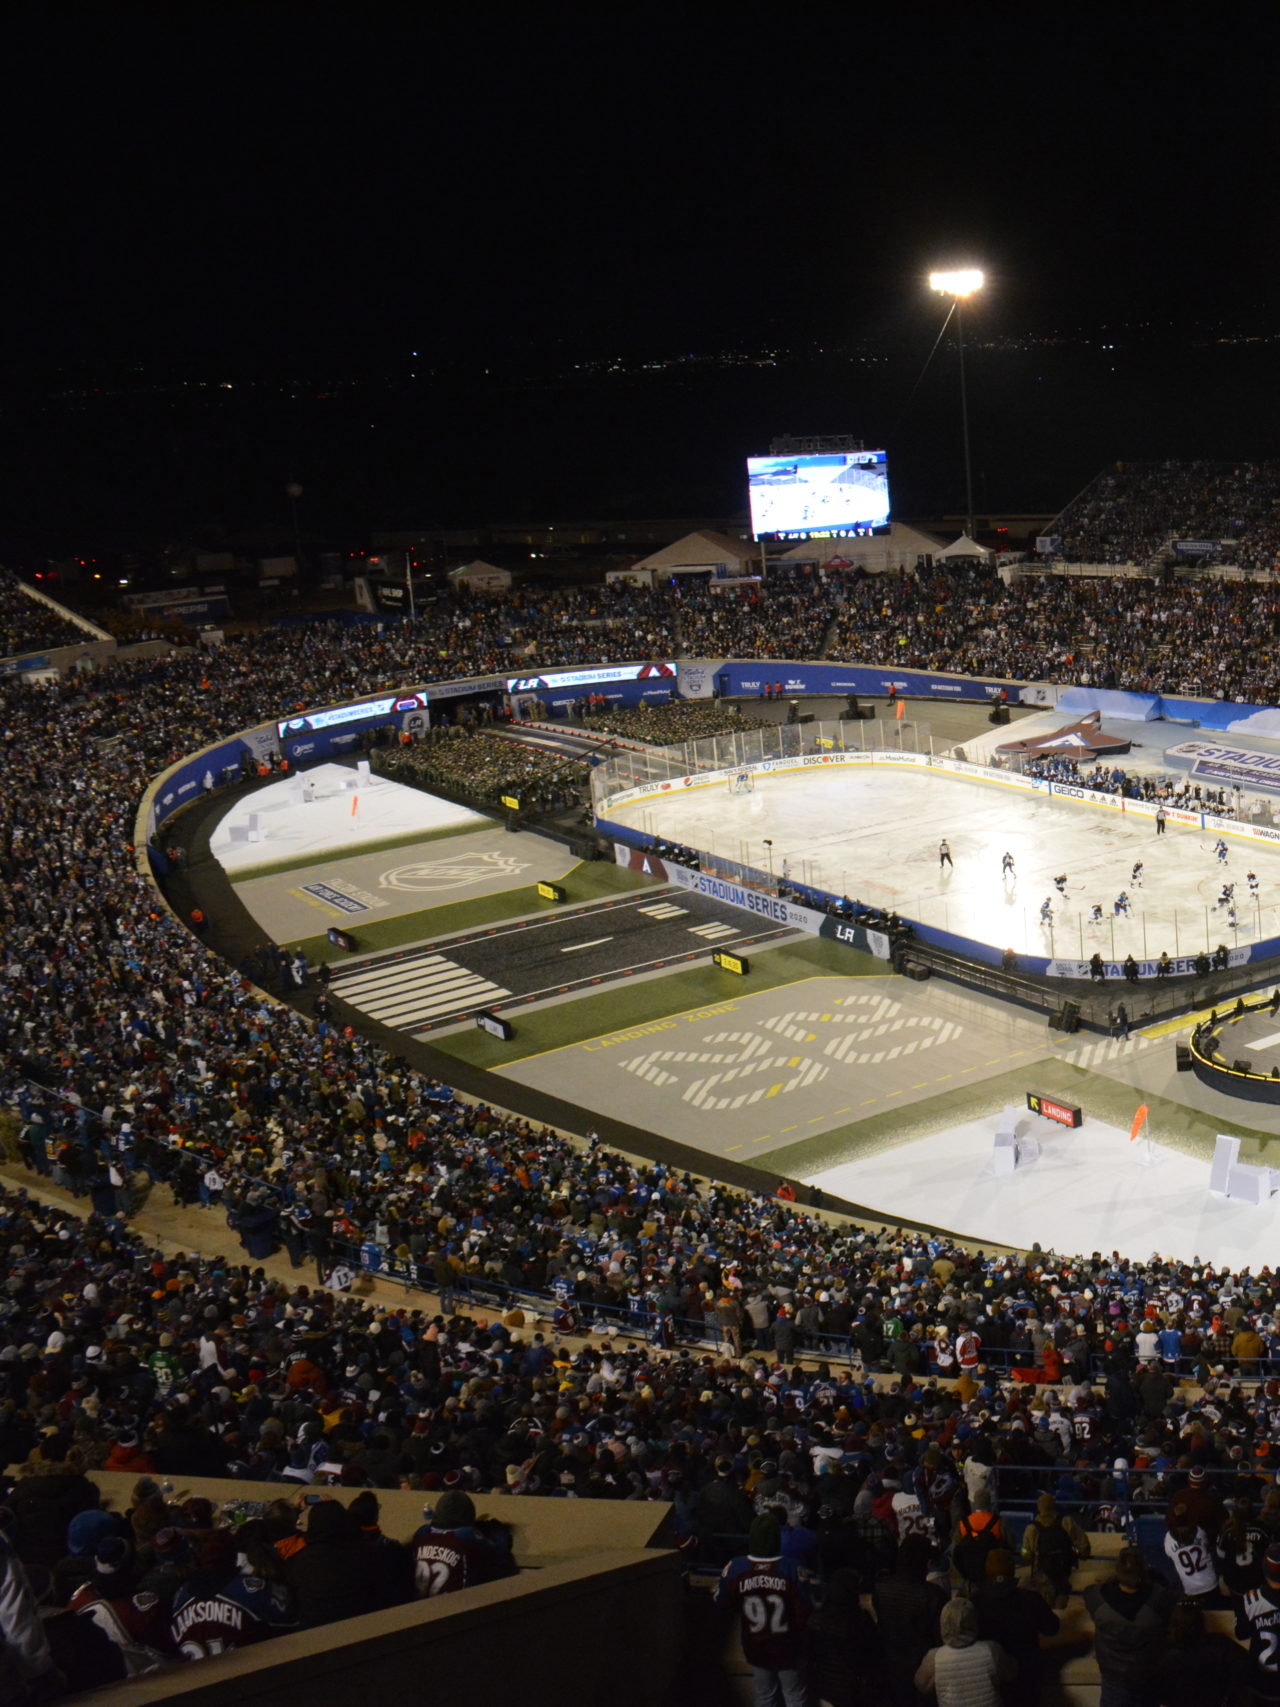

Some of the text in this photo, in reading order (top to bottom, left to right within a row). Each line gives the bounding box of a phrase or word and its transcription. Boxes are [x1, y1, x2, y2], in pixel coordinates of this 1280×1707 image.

[518, 678, 539, 690] LA
[803, 754, 845, 766] DISCOVER
[638, 783, 659, 794] TRULY
[1053, 783, 1084, 799] GEICO
[699, 876, 747, 906] STADIUM
[747, 893, 788, 922] SERIES
[789, 911, 808, 924] 2020
[836, 924, 855, 943] LA
[582, 1002, 741, 1053] LANDING ZONE
[1043, 1103, 1072, 1123] LANDING
[882, 1323, 895, 1337] 17
[1074, 1422, 1092, 1440] 92
[416, 1545, 461, 1568] ANDESKOG
[1177, 1546, 1208, 1576] 92
[738, 1574, 786, 1592] LANDESKOG
[743, 1594, 790, 1634] 92
